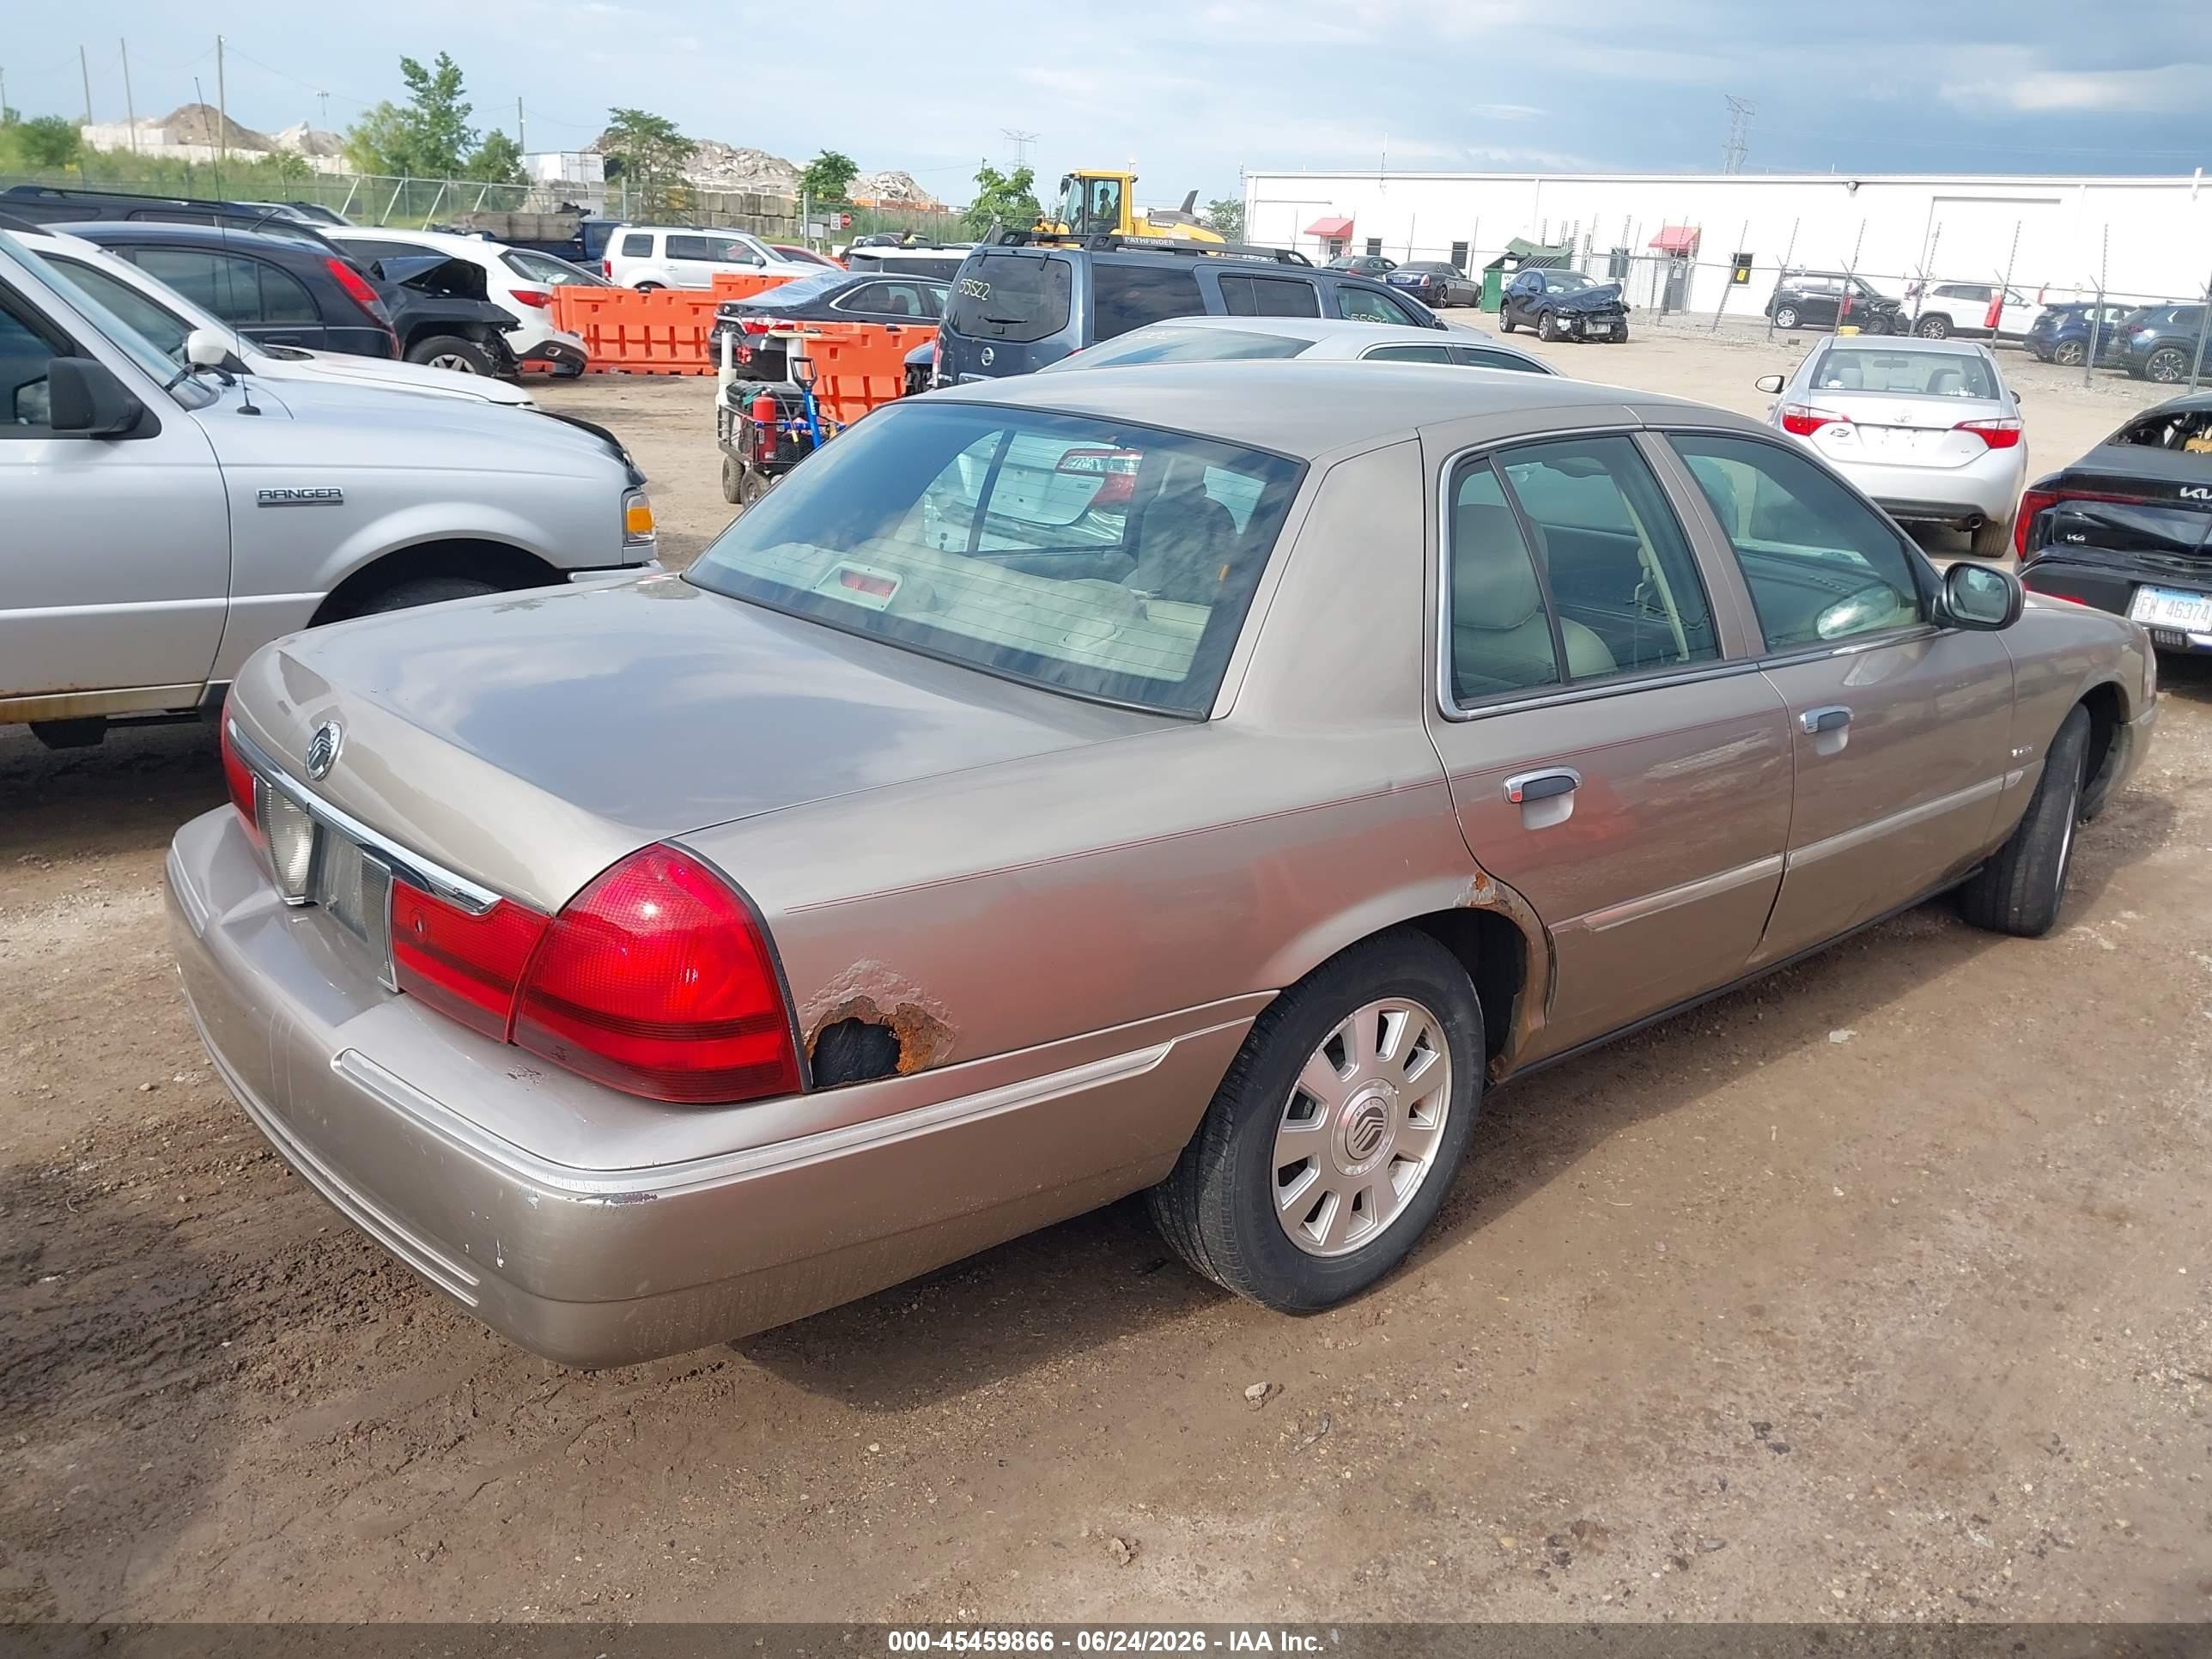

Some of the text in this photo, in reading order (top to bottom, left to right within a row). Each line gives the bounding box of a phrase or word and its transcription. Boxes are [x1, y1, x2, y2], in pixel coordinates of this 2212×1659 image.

[1124, 236, 1176, 246] PATHFINDER
[258, 488, 343, 499] RANGER
[2166, 600, 2211, 623] 46374
